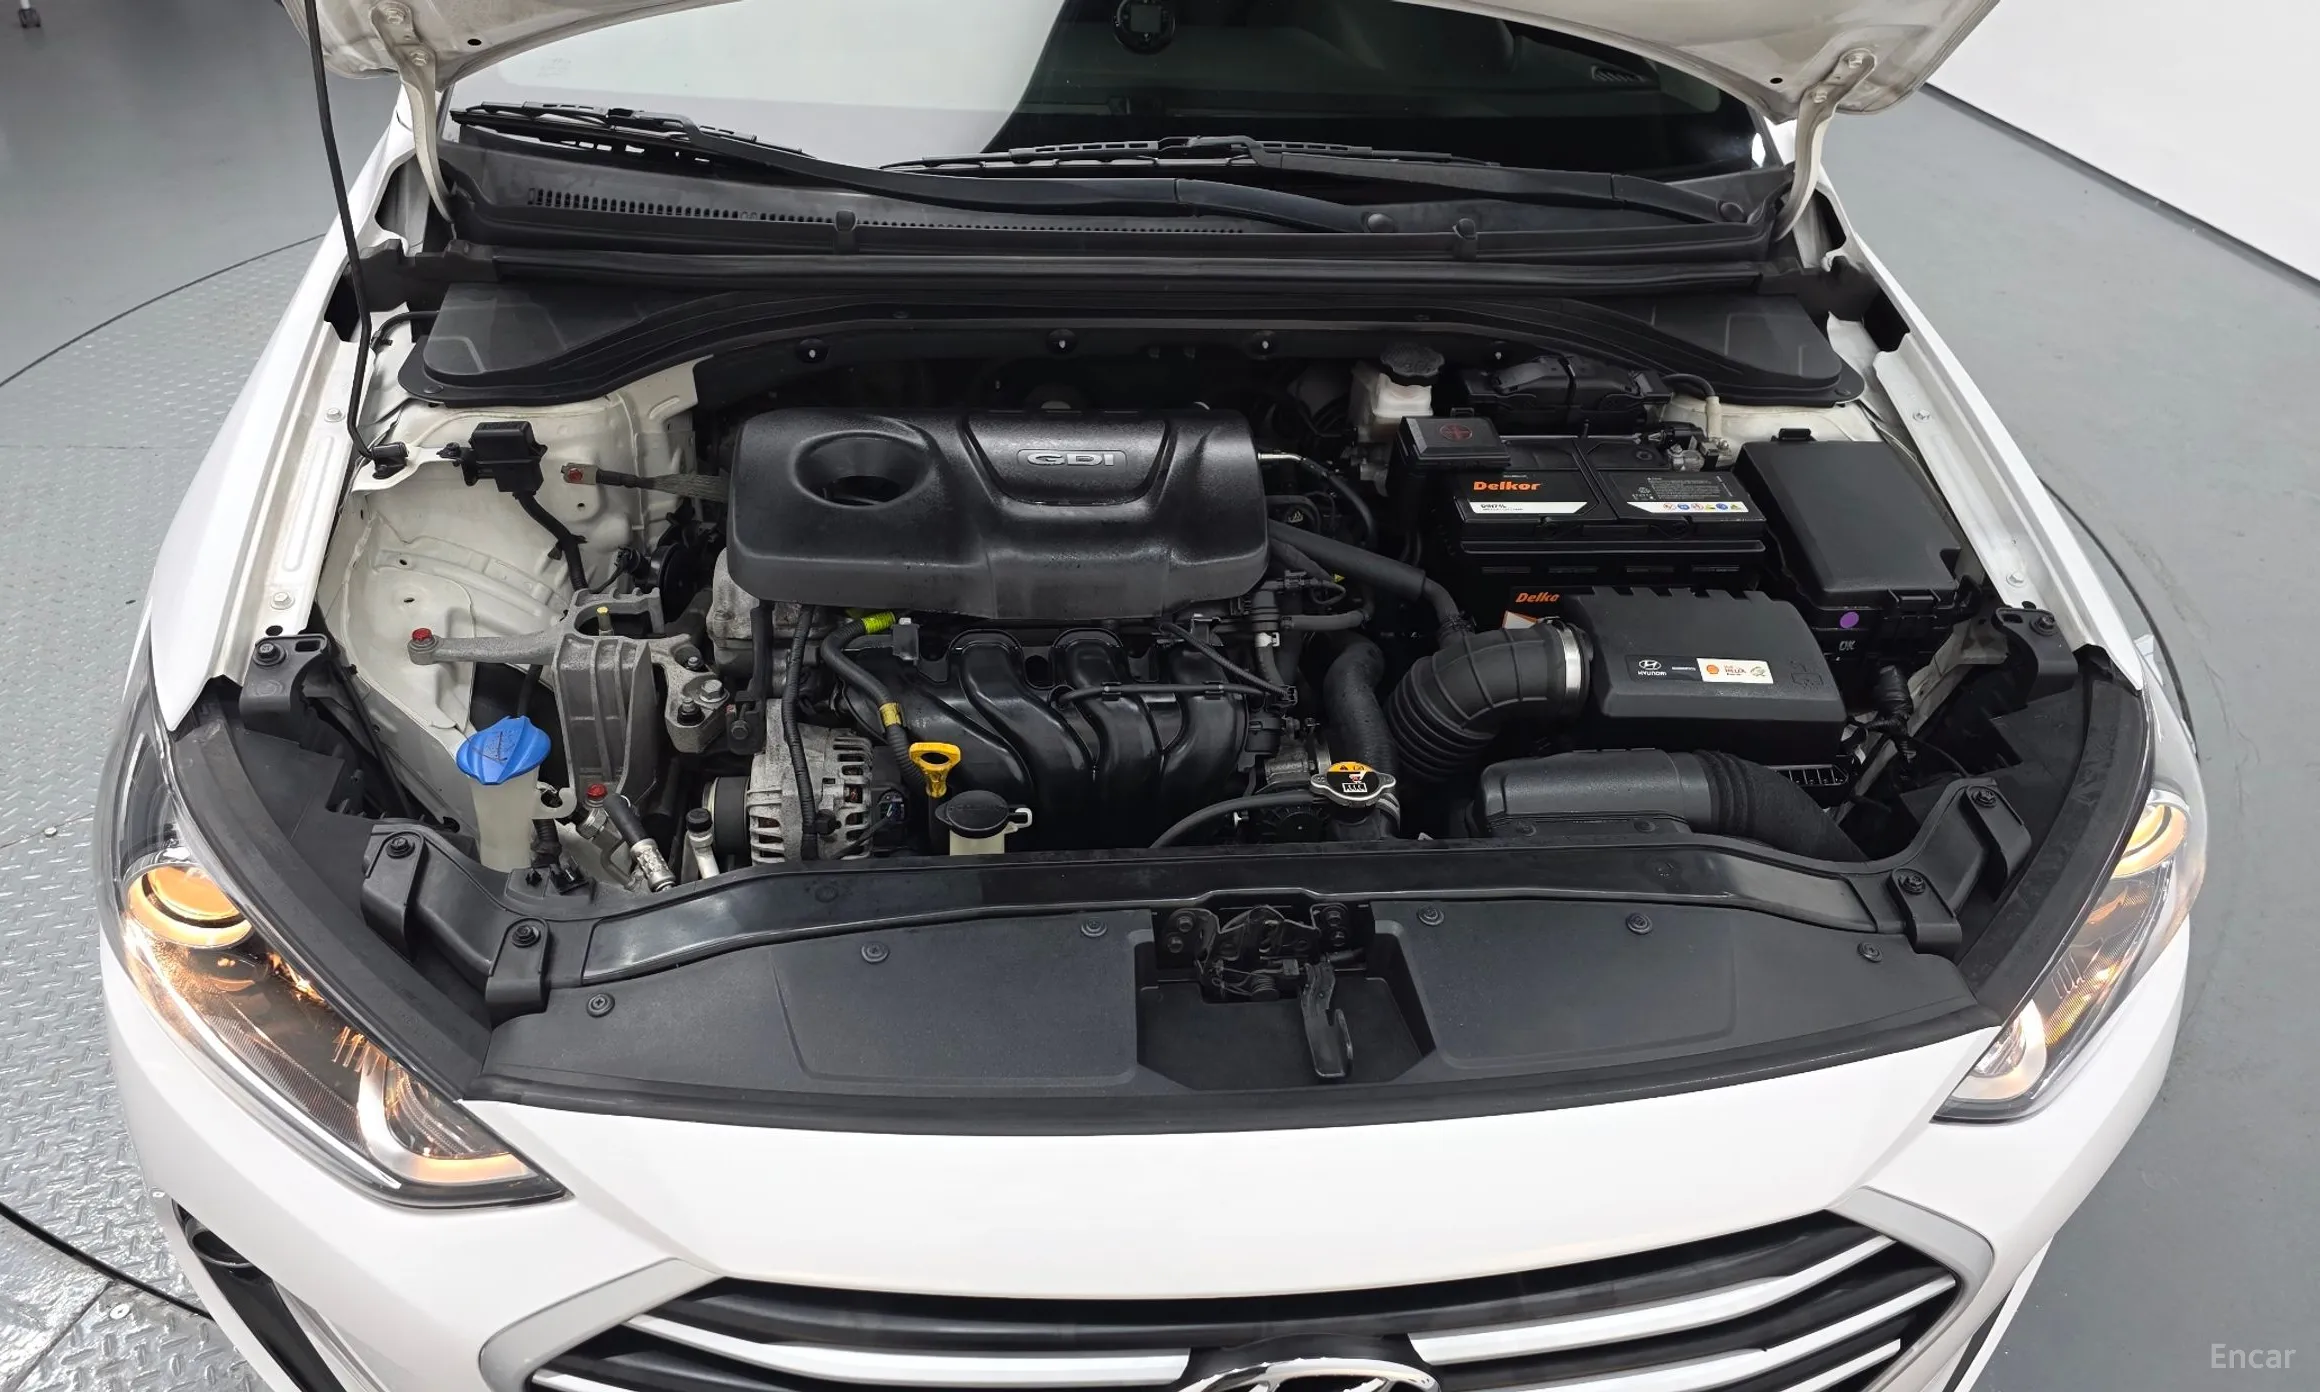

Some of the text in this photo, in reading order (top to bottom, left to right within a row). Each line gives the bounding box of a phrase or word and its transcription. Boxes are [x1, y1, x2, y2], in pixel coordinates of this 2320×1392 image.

[1027, 453, 1114, 466] GDI
[1473, 481, 1541, 490] Delkor
[1515, 591, 1560, 603] Delko
